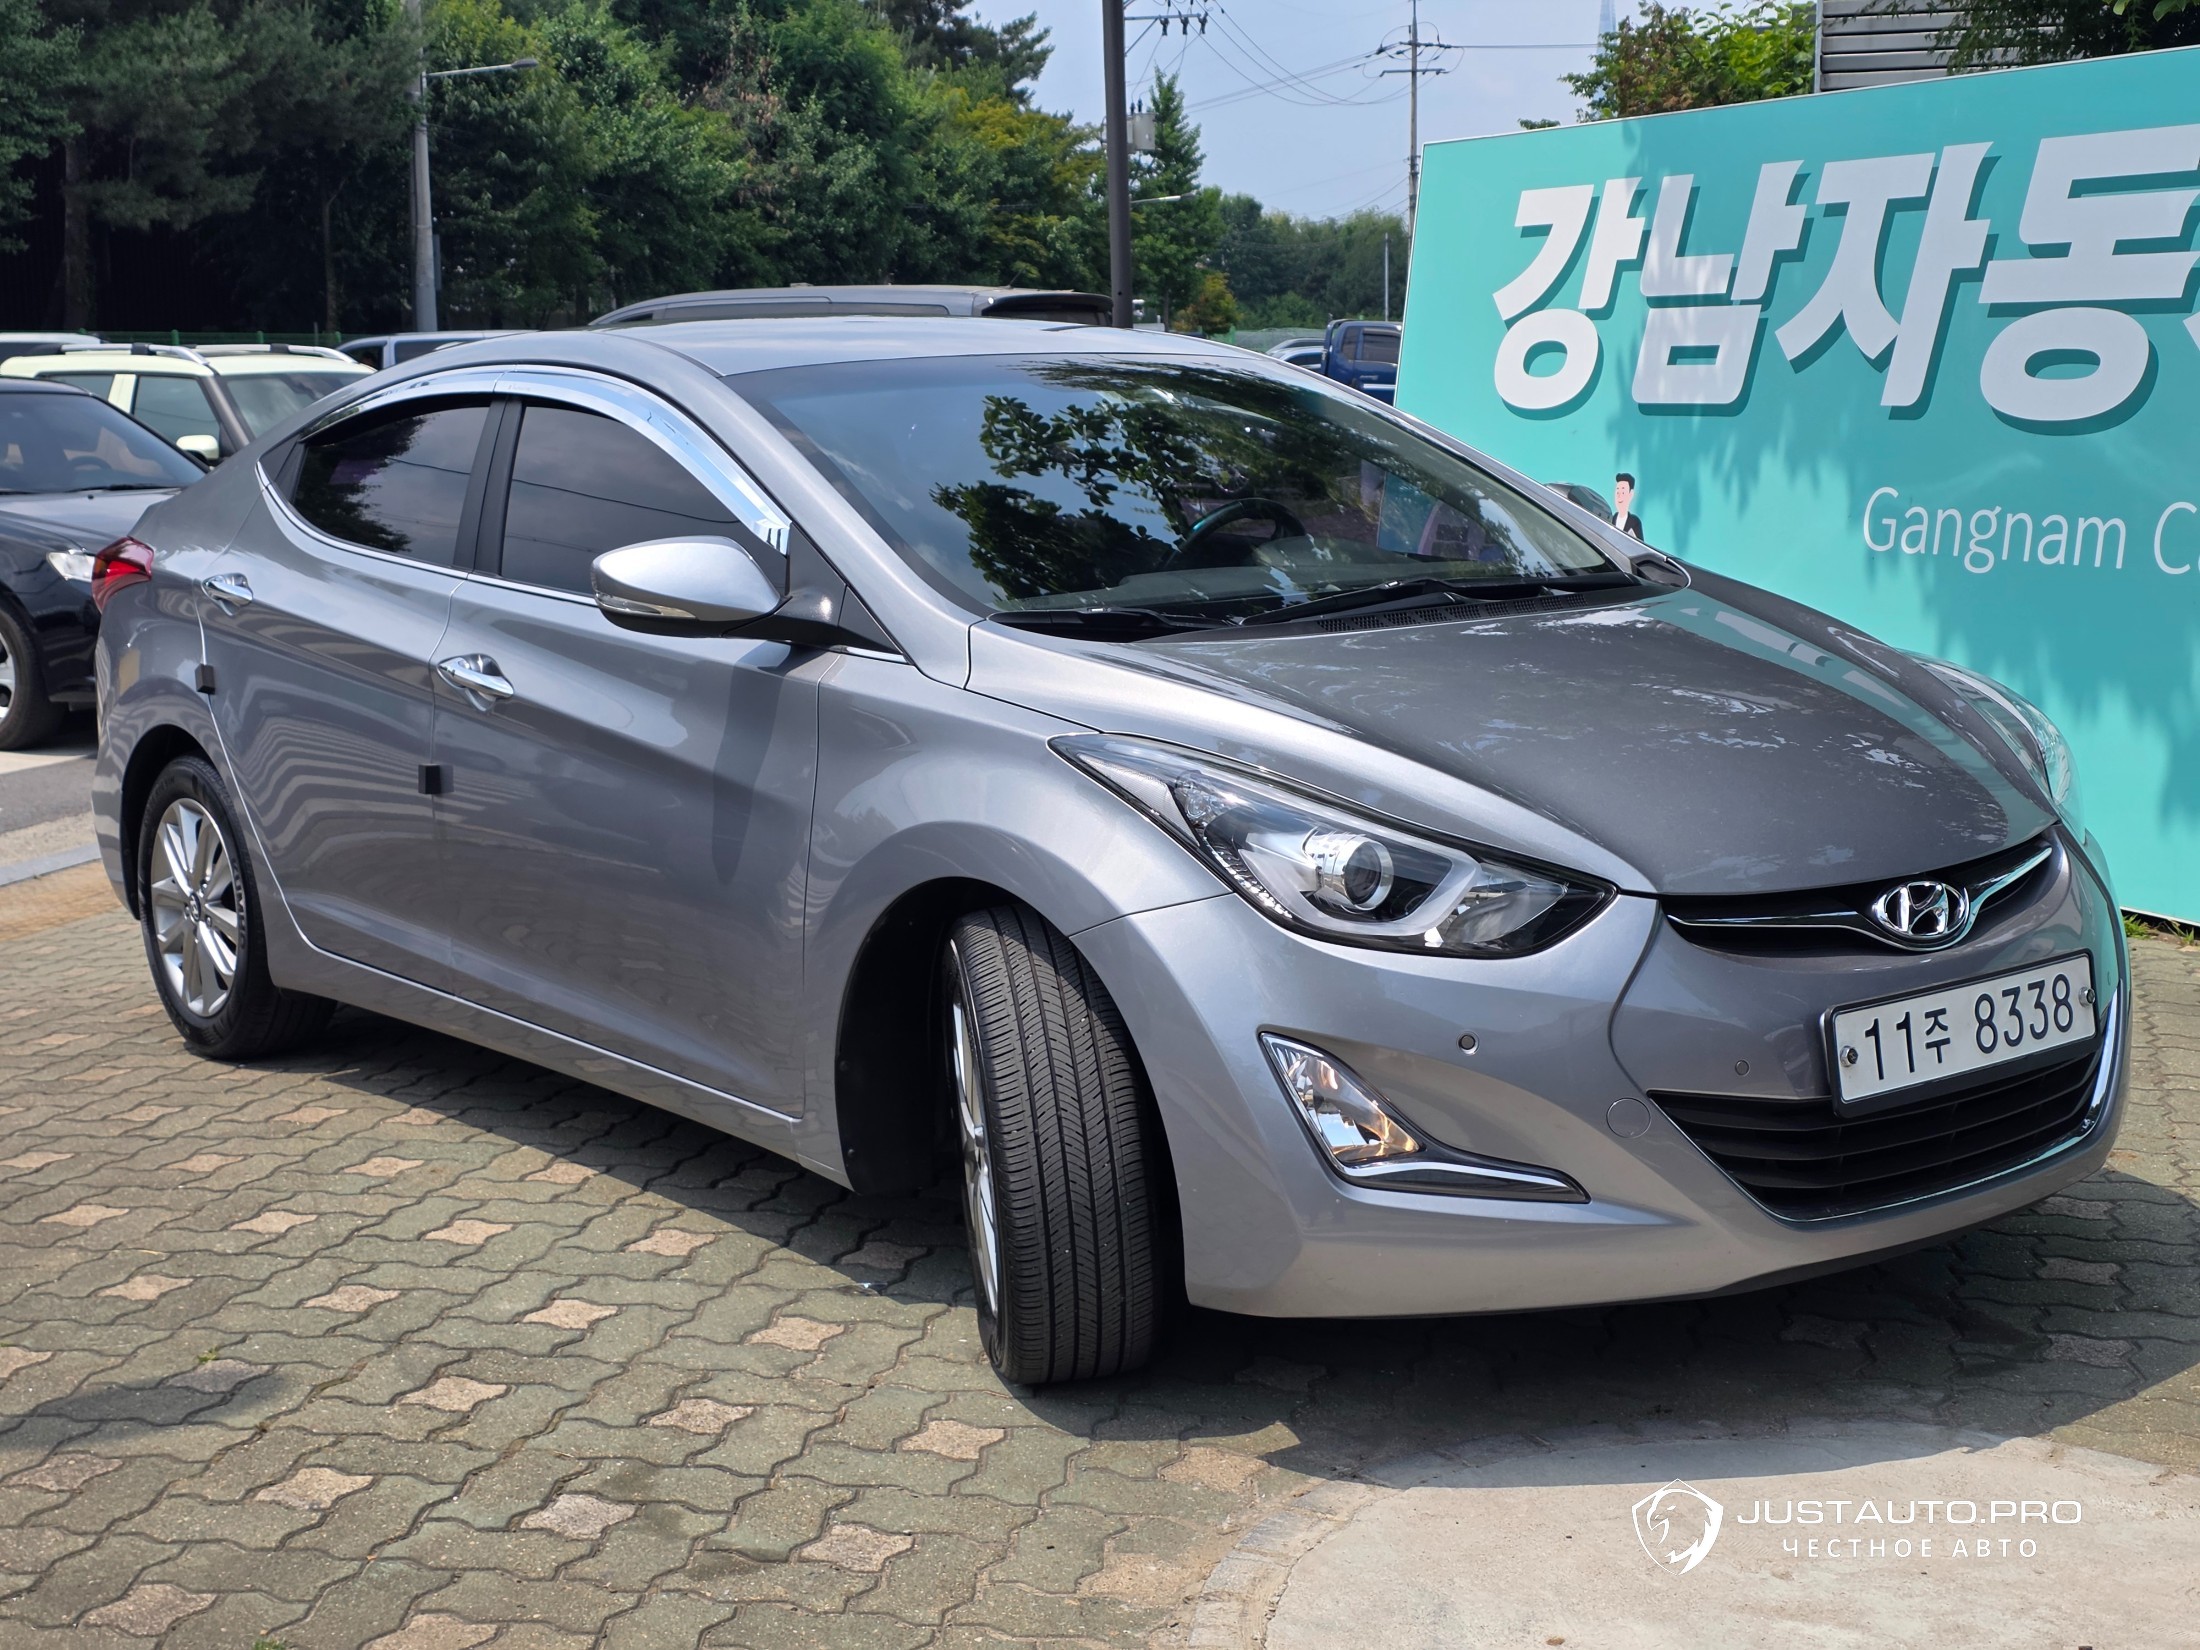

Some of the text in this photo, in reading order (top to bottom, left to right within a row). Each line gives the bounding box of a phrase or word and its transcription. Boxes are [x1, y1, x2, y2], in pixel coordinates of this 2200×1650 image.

[1493, 124, 2200, 421] 강남자동
[1863, 486, 2200, 575] Gangnam C
[1864, 973, 2074, 1081] 11주 8338
